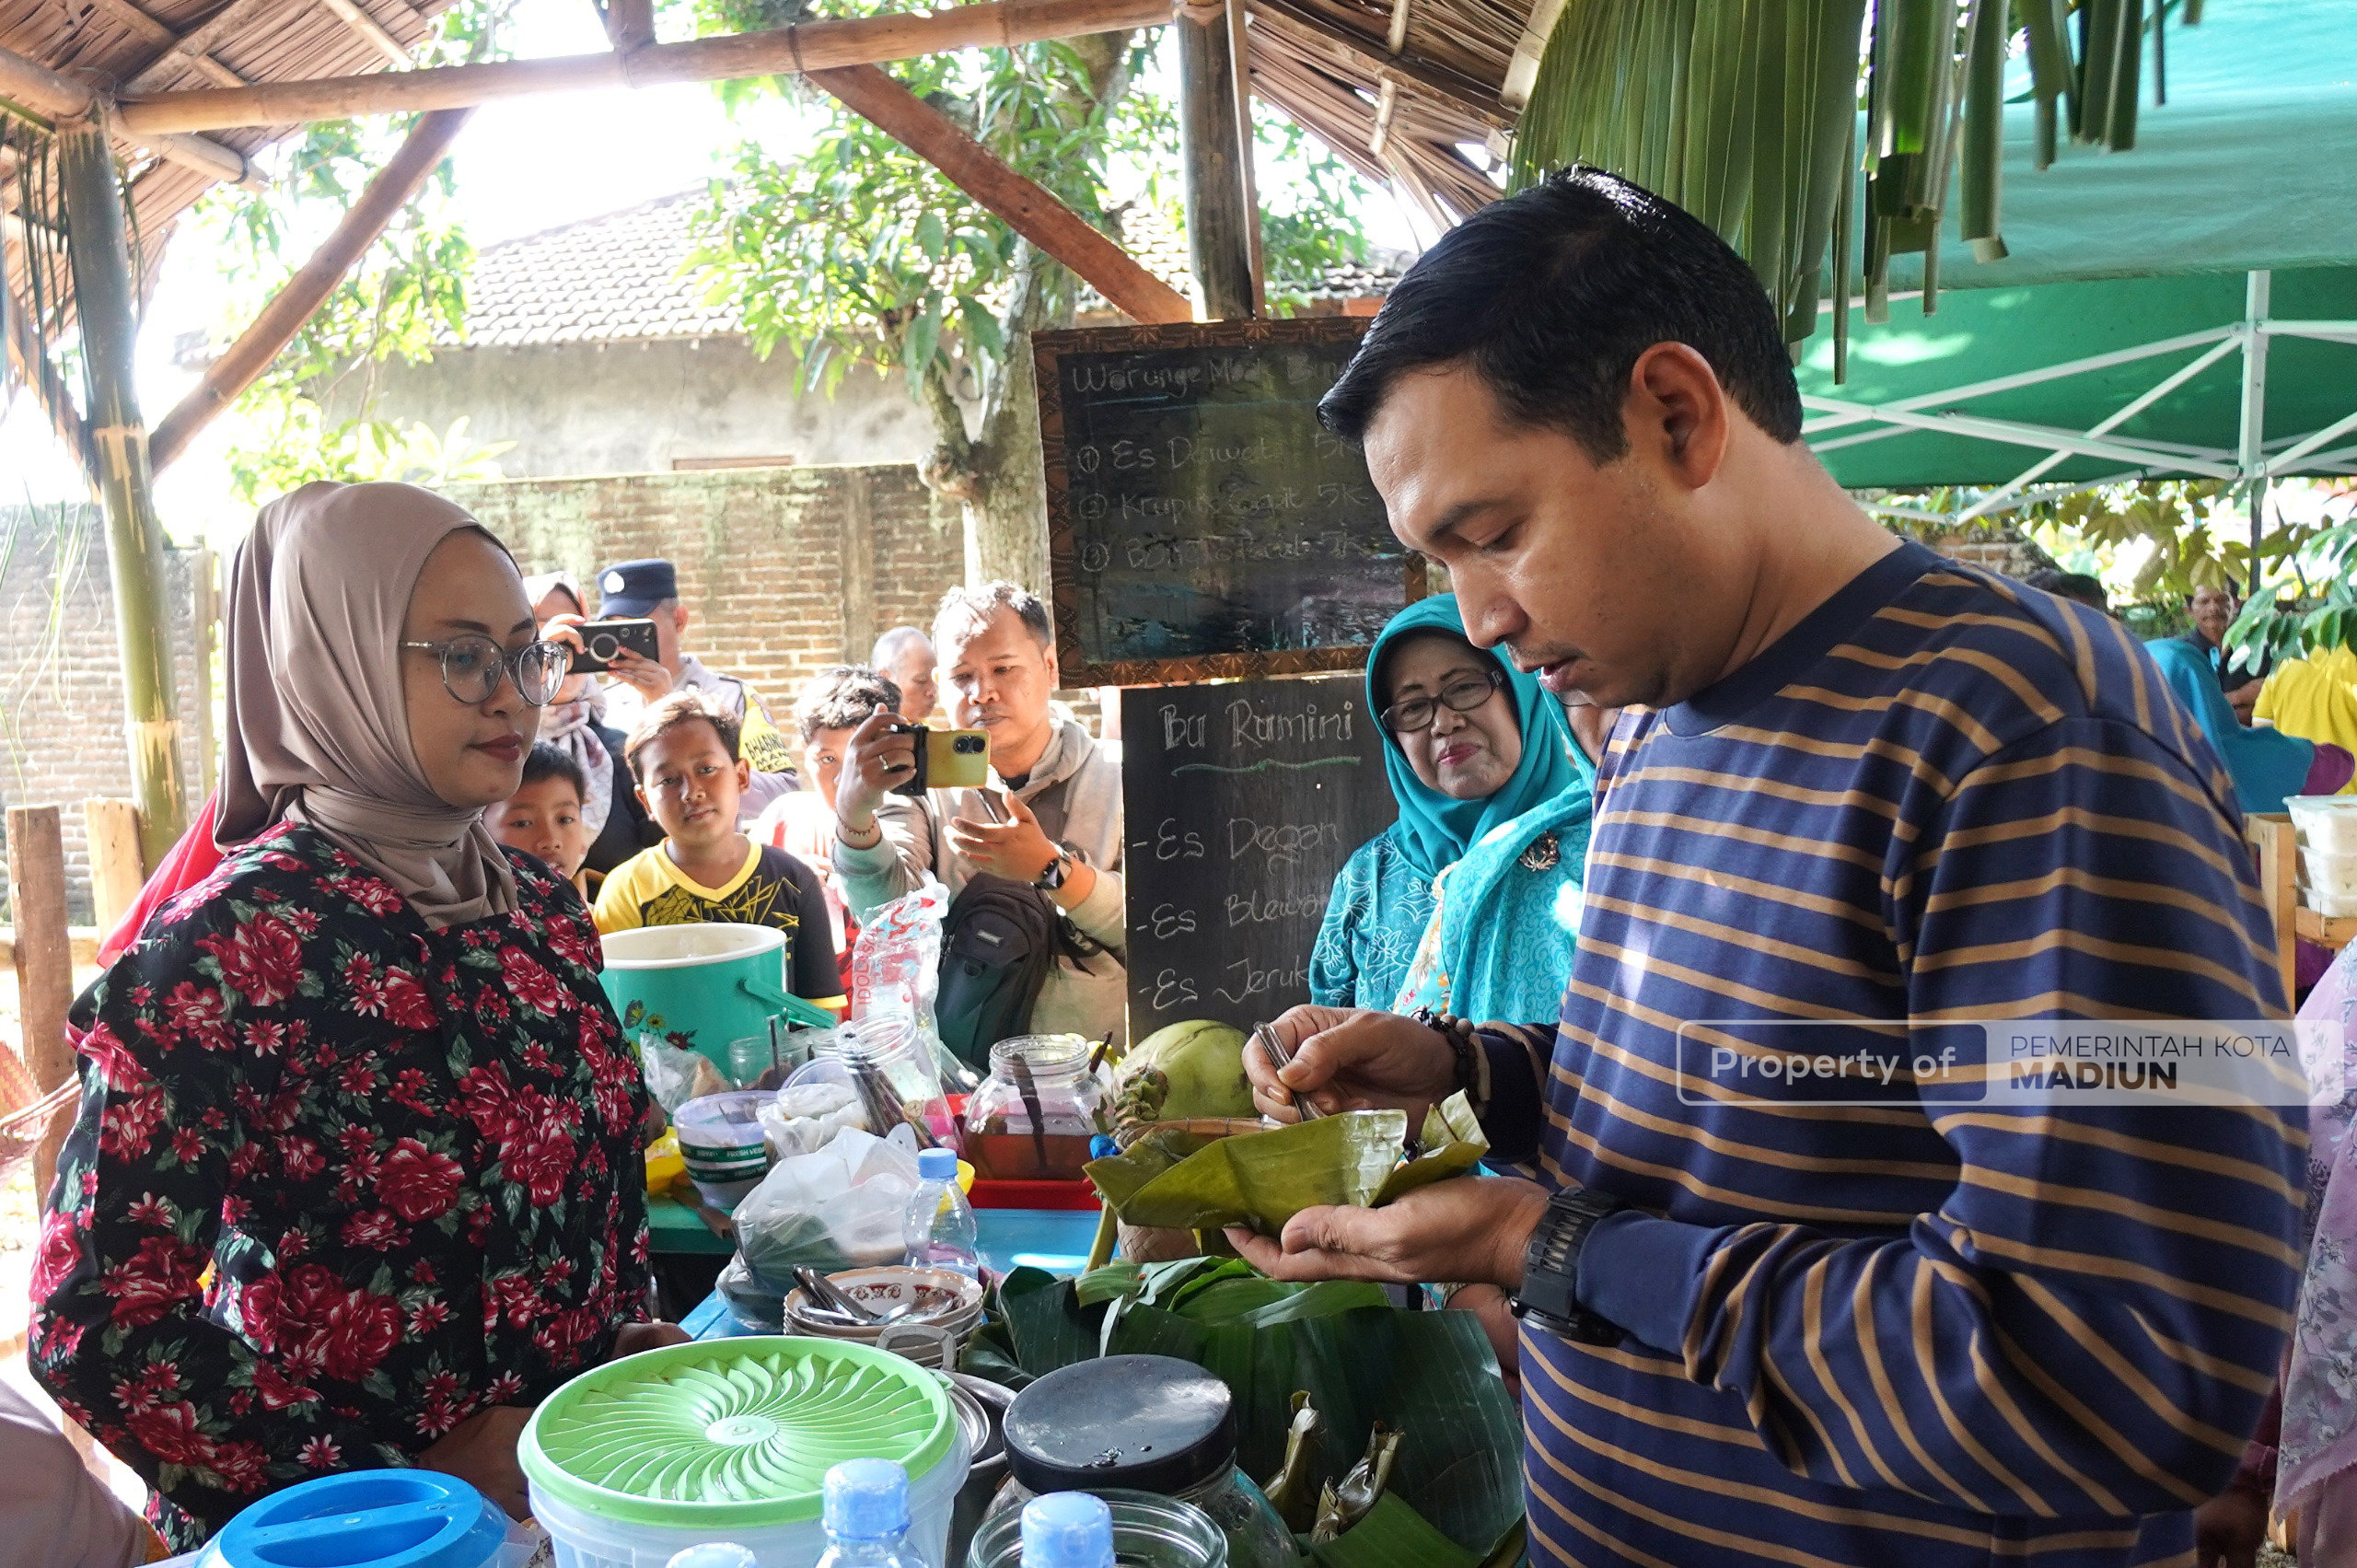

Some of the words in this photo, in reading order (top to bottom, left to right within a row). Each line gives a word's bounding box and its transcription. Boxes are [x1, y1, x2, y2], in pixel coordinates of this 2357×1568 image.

[1111, 439, 1156, 470] Es
[1318, 481, 1370, 508] 5K
[1158, 703, 1207, 750] Bu
[1225, 698, 1353, 749] Rumini
[1211, 954, 1310, 1005] Jeruk
